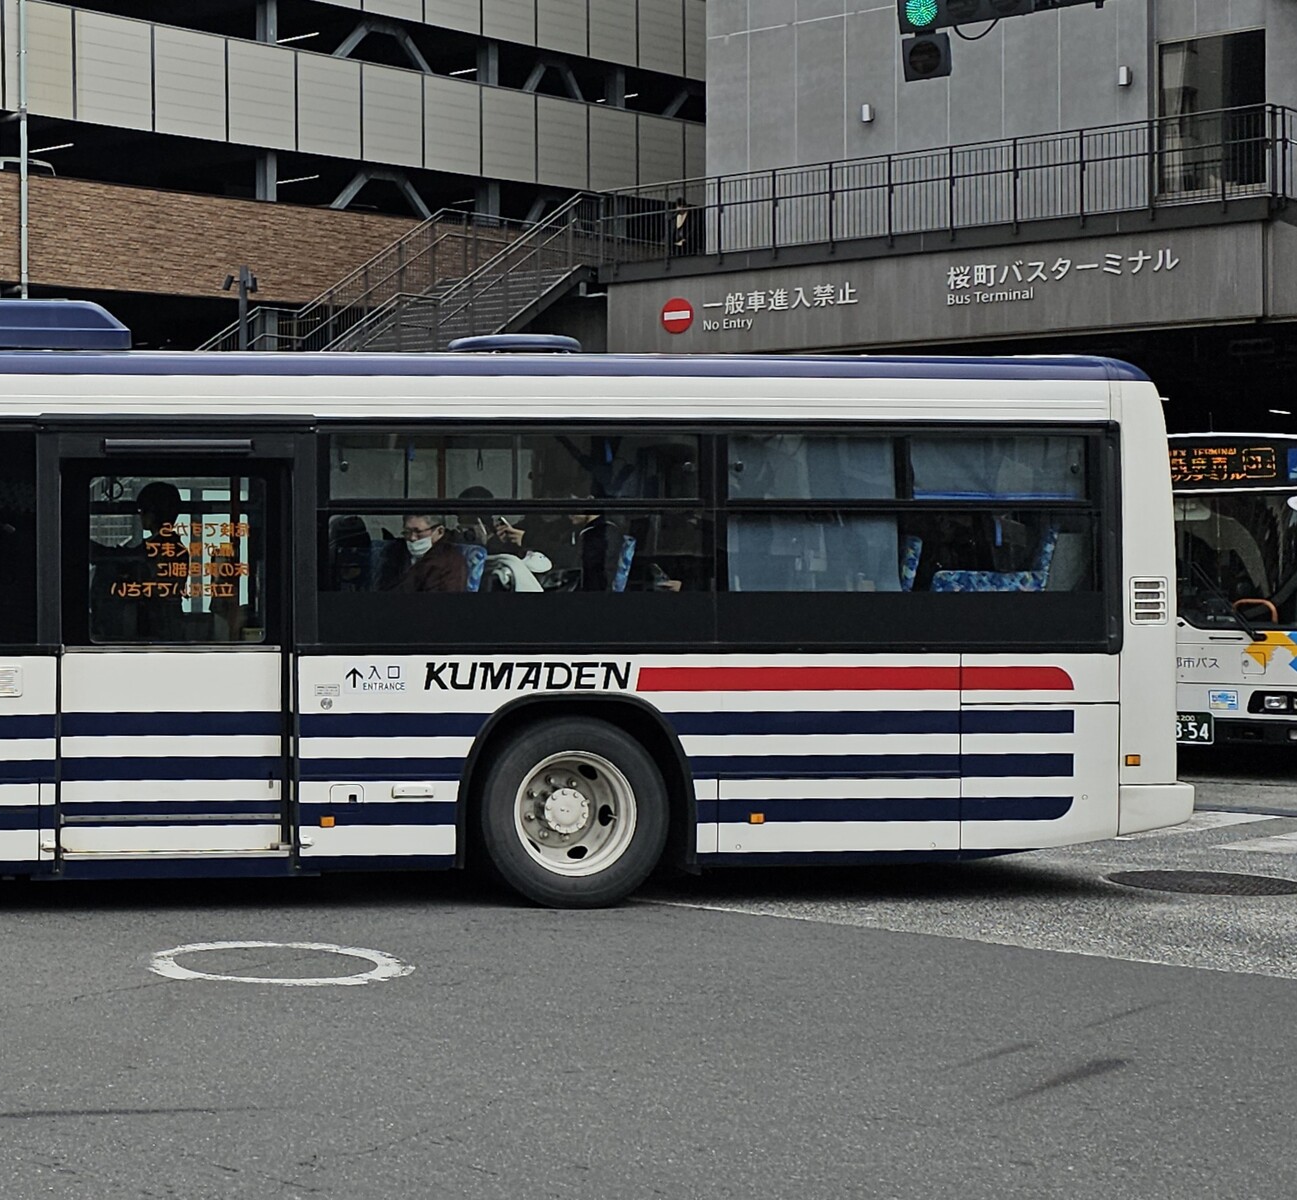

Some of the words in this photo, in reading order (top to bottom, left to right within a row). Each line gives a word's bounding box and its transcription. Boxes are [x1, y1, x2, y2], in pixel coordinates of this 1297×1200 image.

[946, 248, 1180, 291] 桜町バスターミナル
[702, 281, 859, 315] 一般車進入禁止
[946, 293, 971, 306] Bus
[974, 287, 1034, 304] Terminal
[703, 320, 720, 331] No
[723, 318, 753, 331] Entry
[368, 665, 400, 679] 入口
[423, 661, 632, 691] KUMADEN
[362, 682, 406, 691] ENTRANCE
